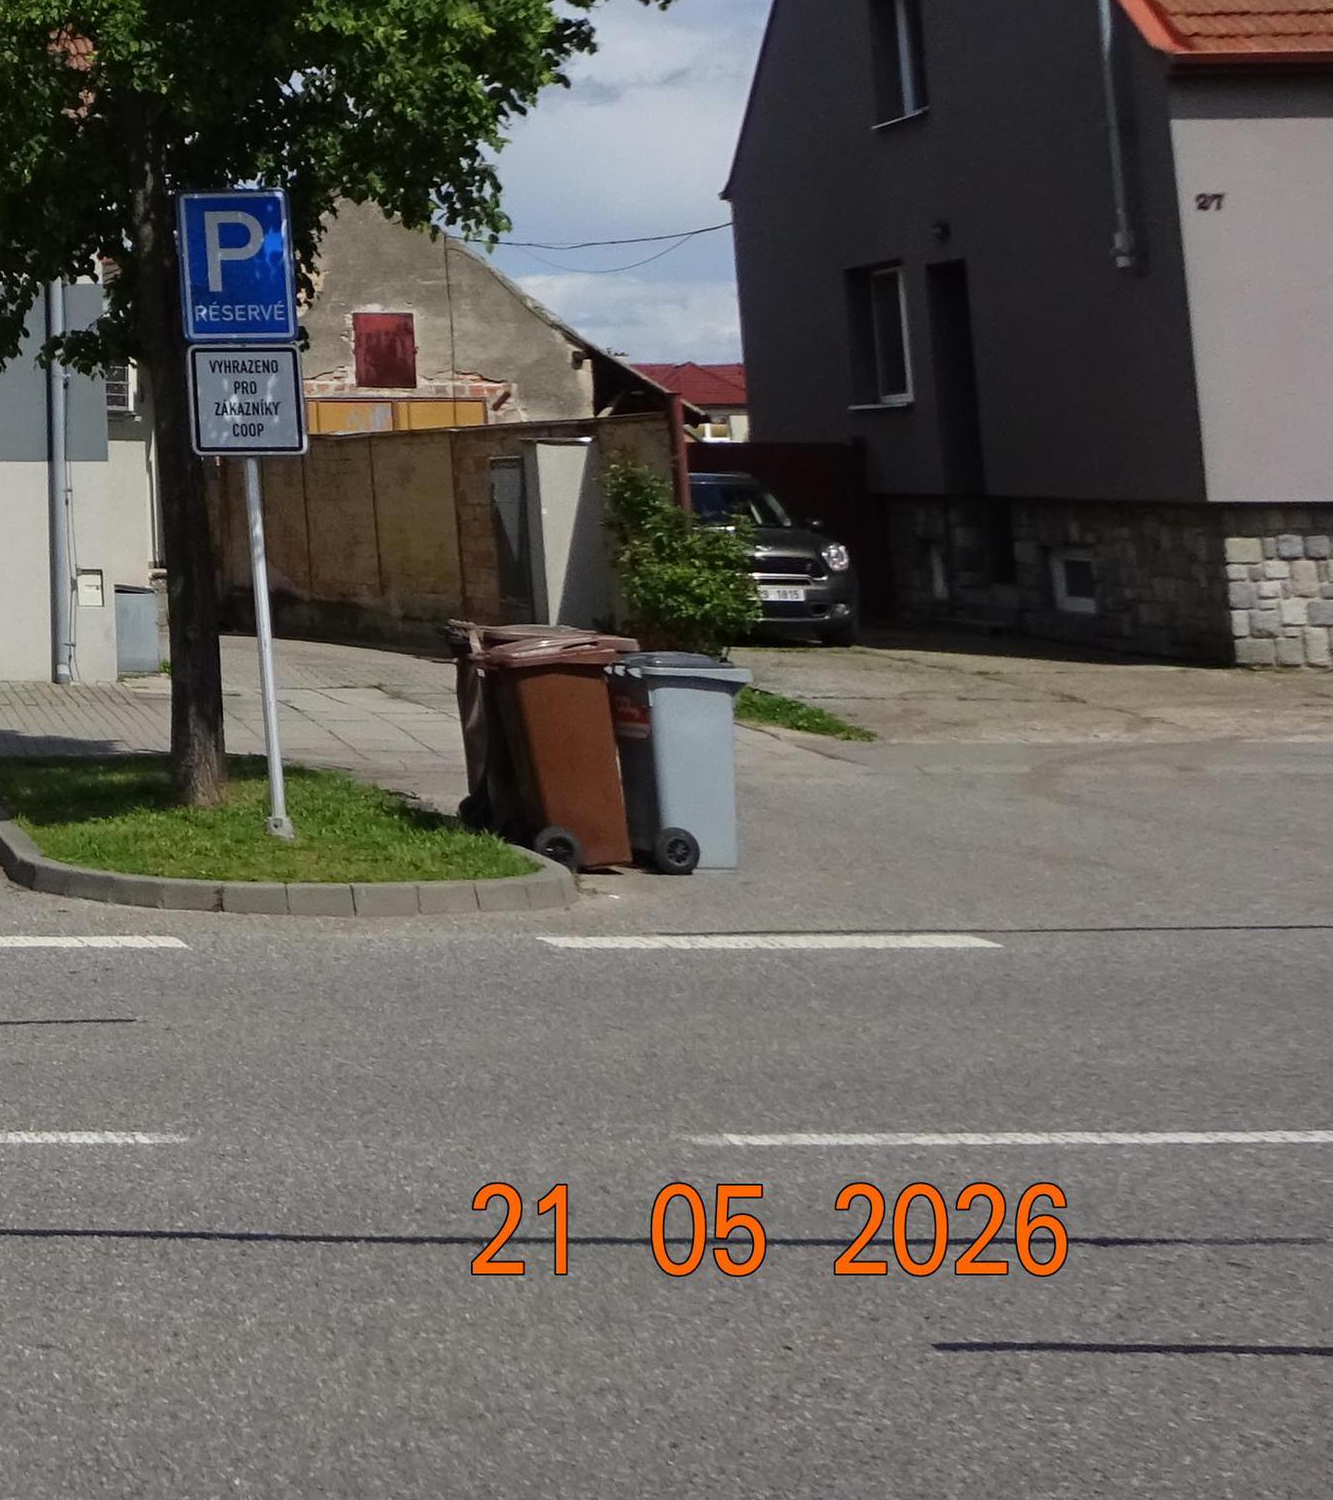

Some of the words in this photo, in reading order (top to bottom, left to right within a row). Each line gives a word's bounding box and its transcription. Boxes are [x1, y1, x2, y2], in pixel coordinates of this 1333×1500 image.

[1195, 193, 1225, 211] 27
[204, 211, 264, 291] P
[194, 301, 286, 322] RÉSERVÉ
[209, 359, 279, 374] VYHRAZENO
[233, 380, 257, 395] PRO
[214, 399, 281, 416] ZÁKAZNÍKY
[232, 423, 265, 437] COOP
